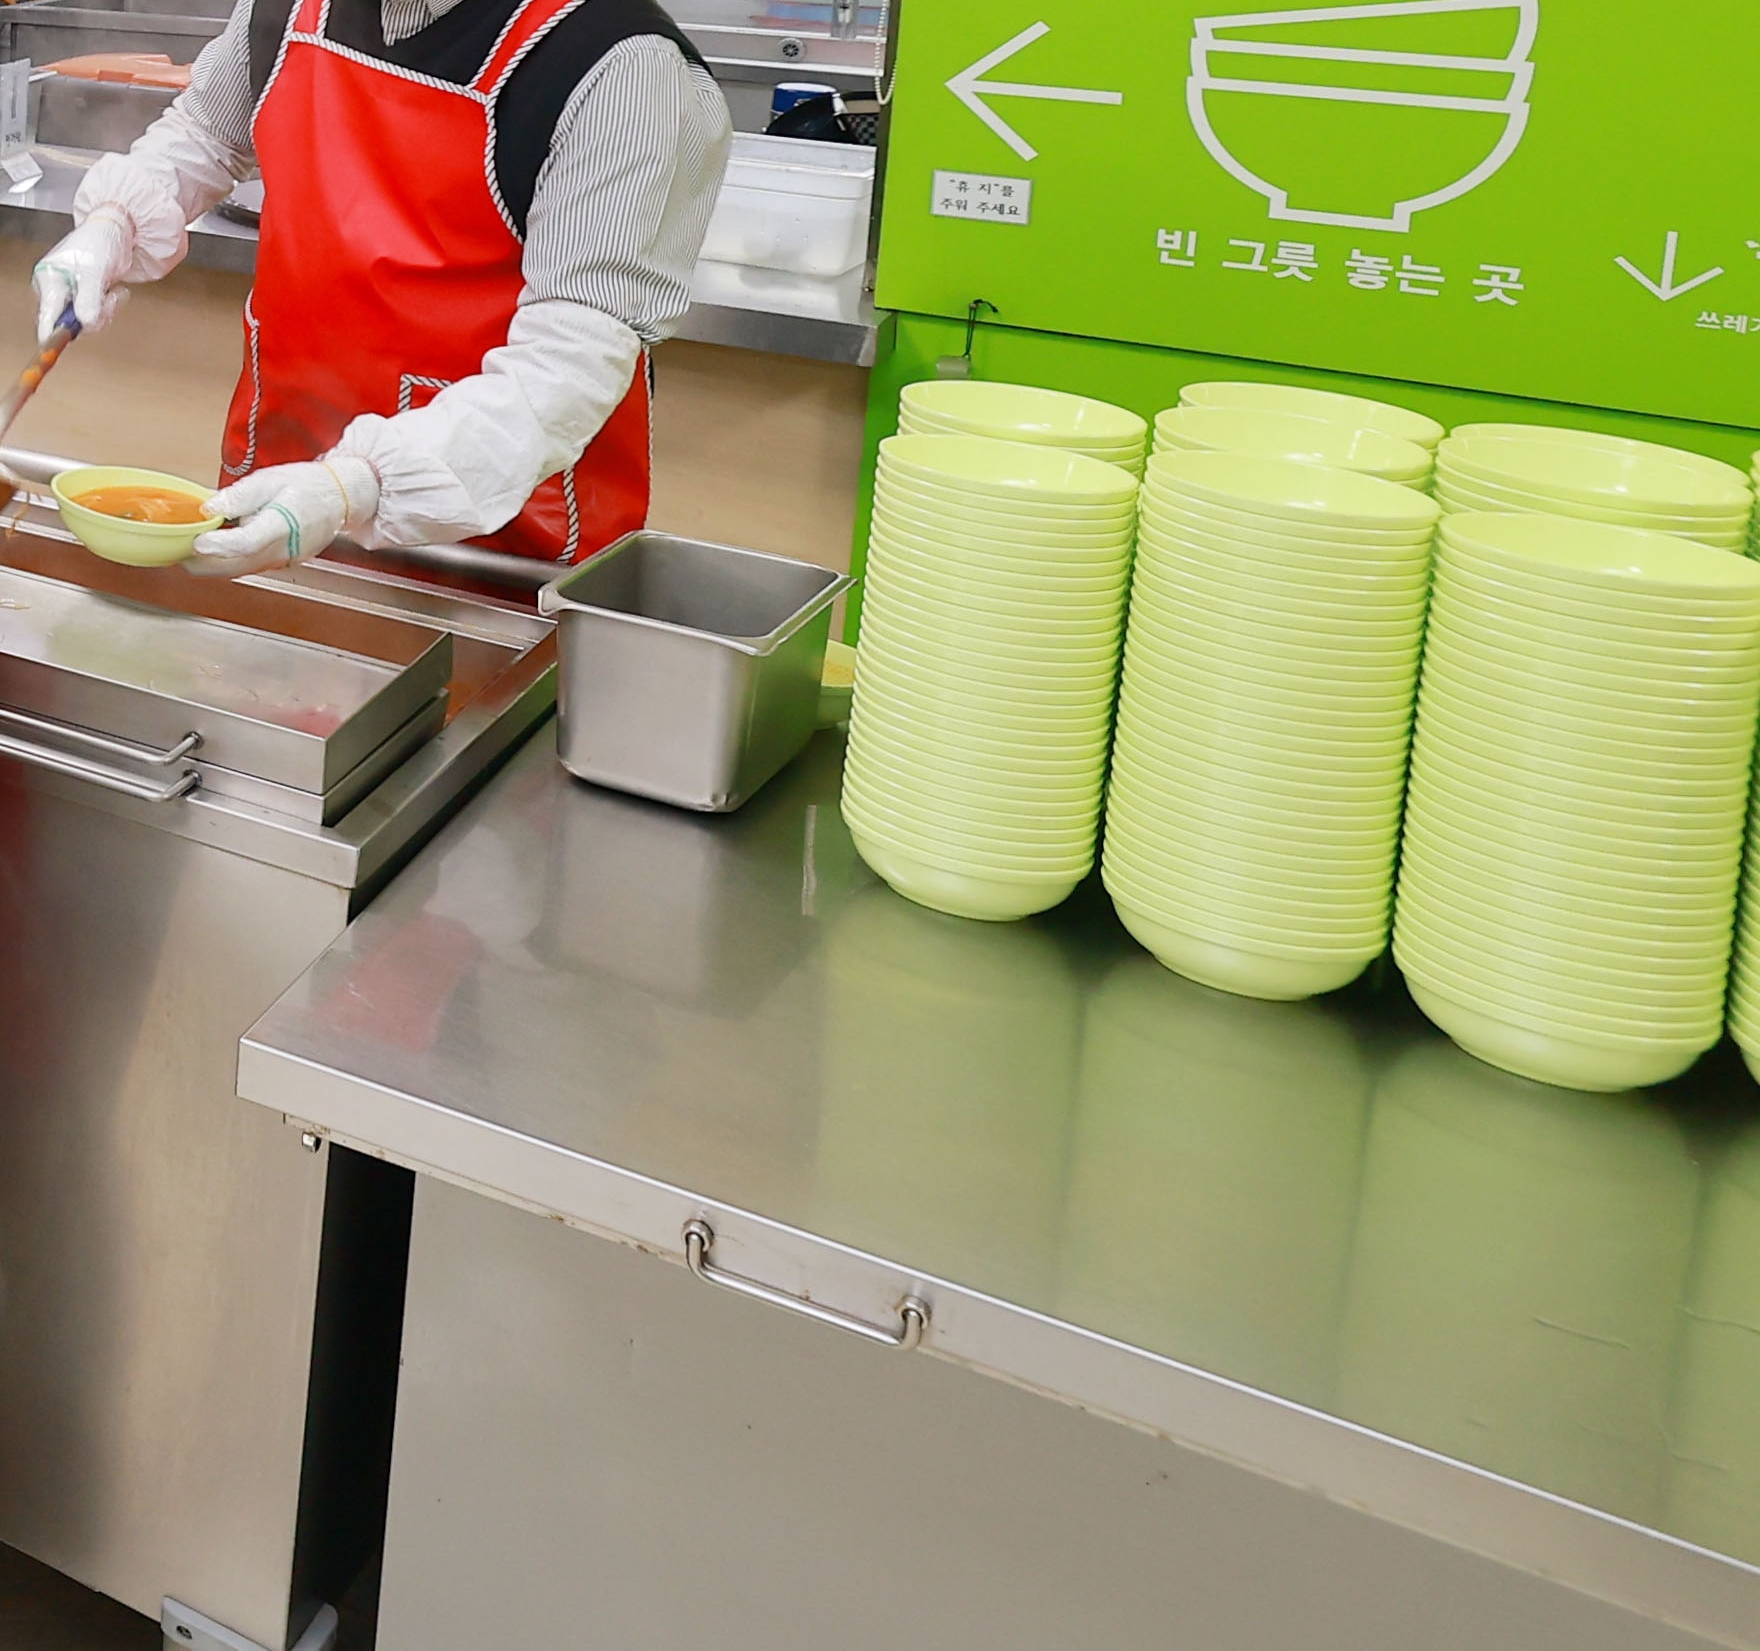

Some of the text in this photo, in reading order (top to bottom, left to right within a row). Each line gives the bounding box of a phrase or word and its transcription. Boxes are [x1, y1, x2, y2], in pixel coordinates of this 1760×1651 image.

[976, 201, 1021, 216] 주세요
[1155, 227, 1525, 307] 빈 그릇 놓는 곳
